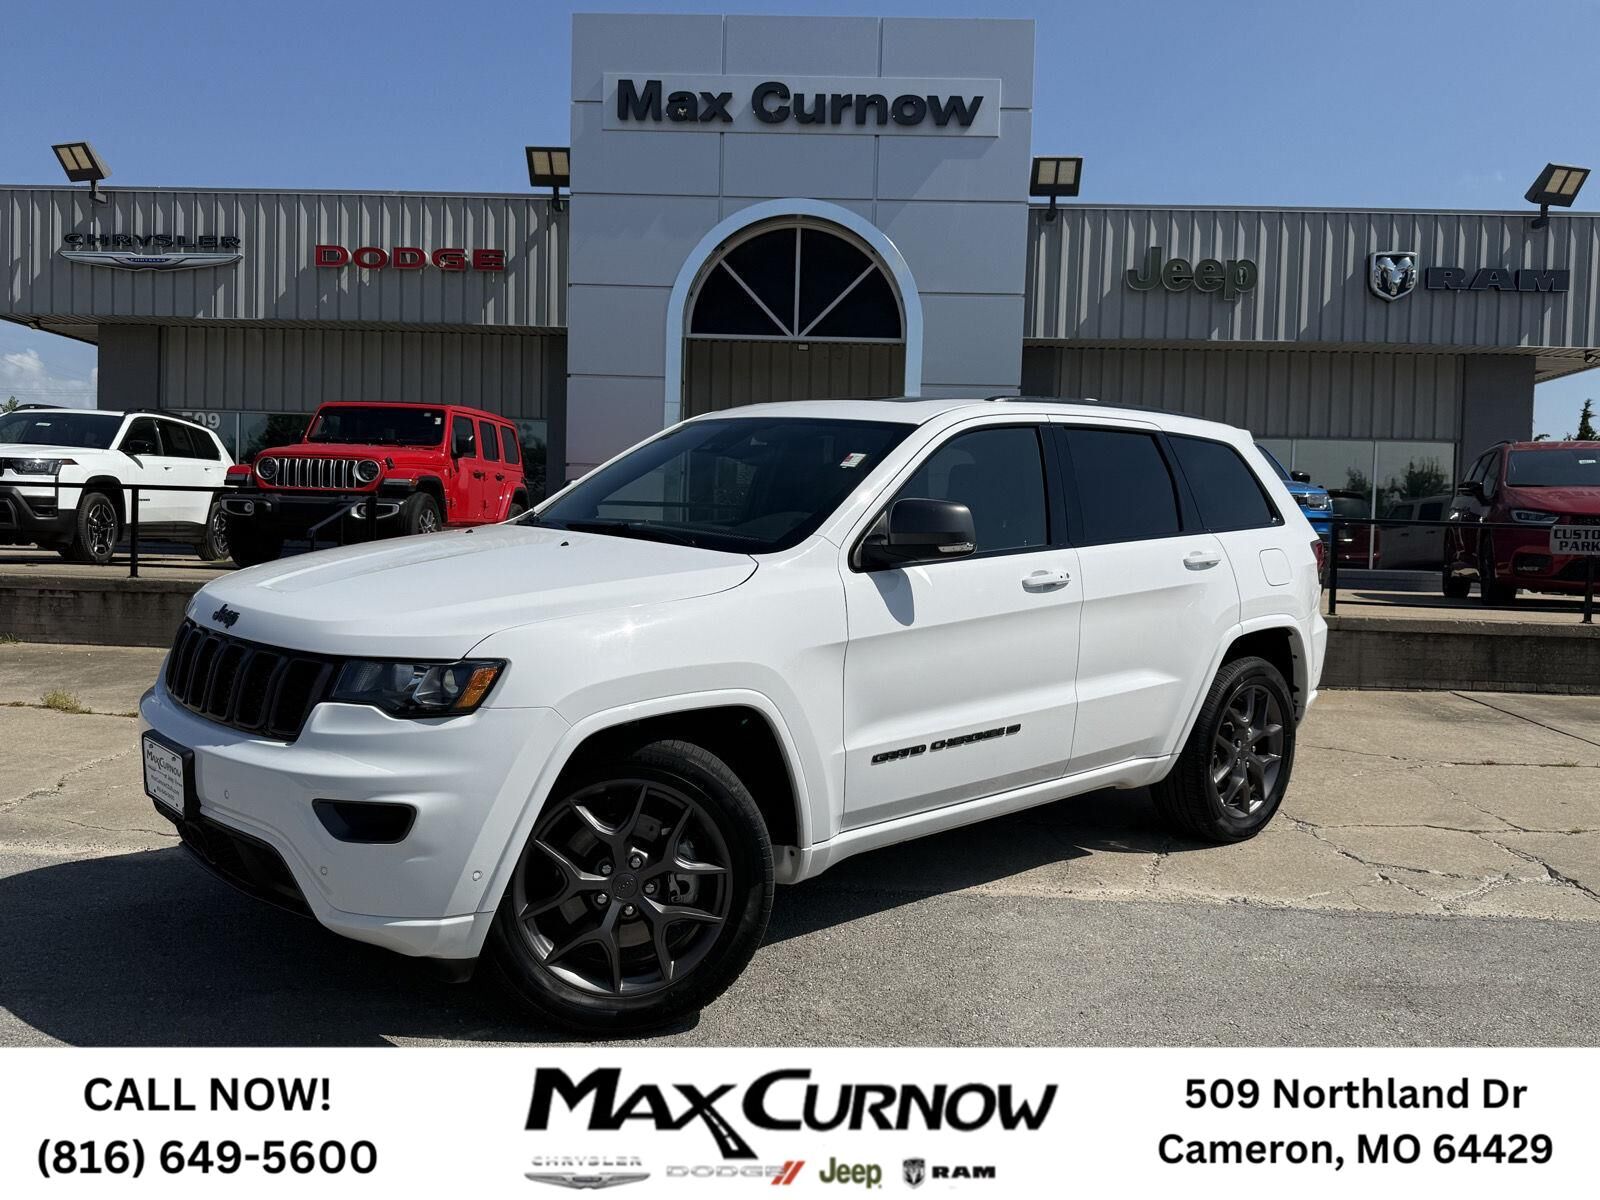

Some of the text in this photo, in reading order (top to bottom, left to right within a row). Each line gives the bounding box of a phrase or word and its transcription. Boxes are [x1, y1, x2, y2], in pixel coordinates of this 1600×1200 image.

[617, 79, 984, 127] Max Curnow
[63, 233, 241, 248] CHRYSLER
[315, 245, 506, 271] DODGE
[1126, 246, 1258, 301] Jeep
[1426, 267, 1570, 292] RAM
[212, 603, 240, 629] Jeep
